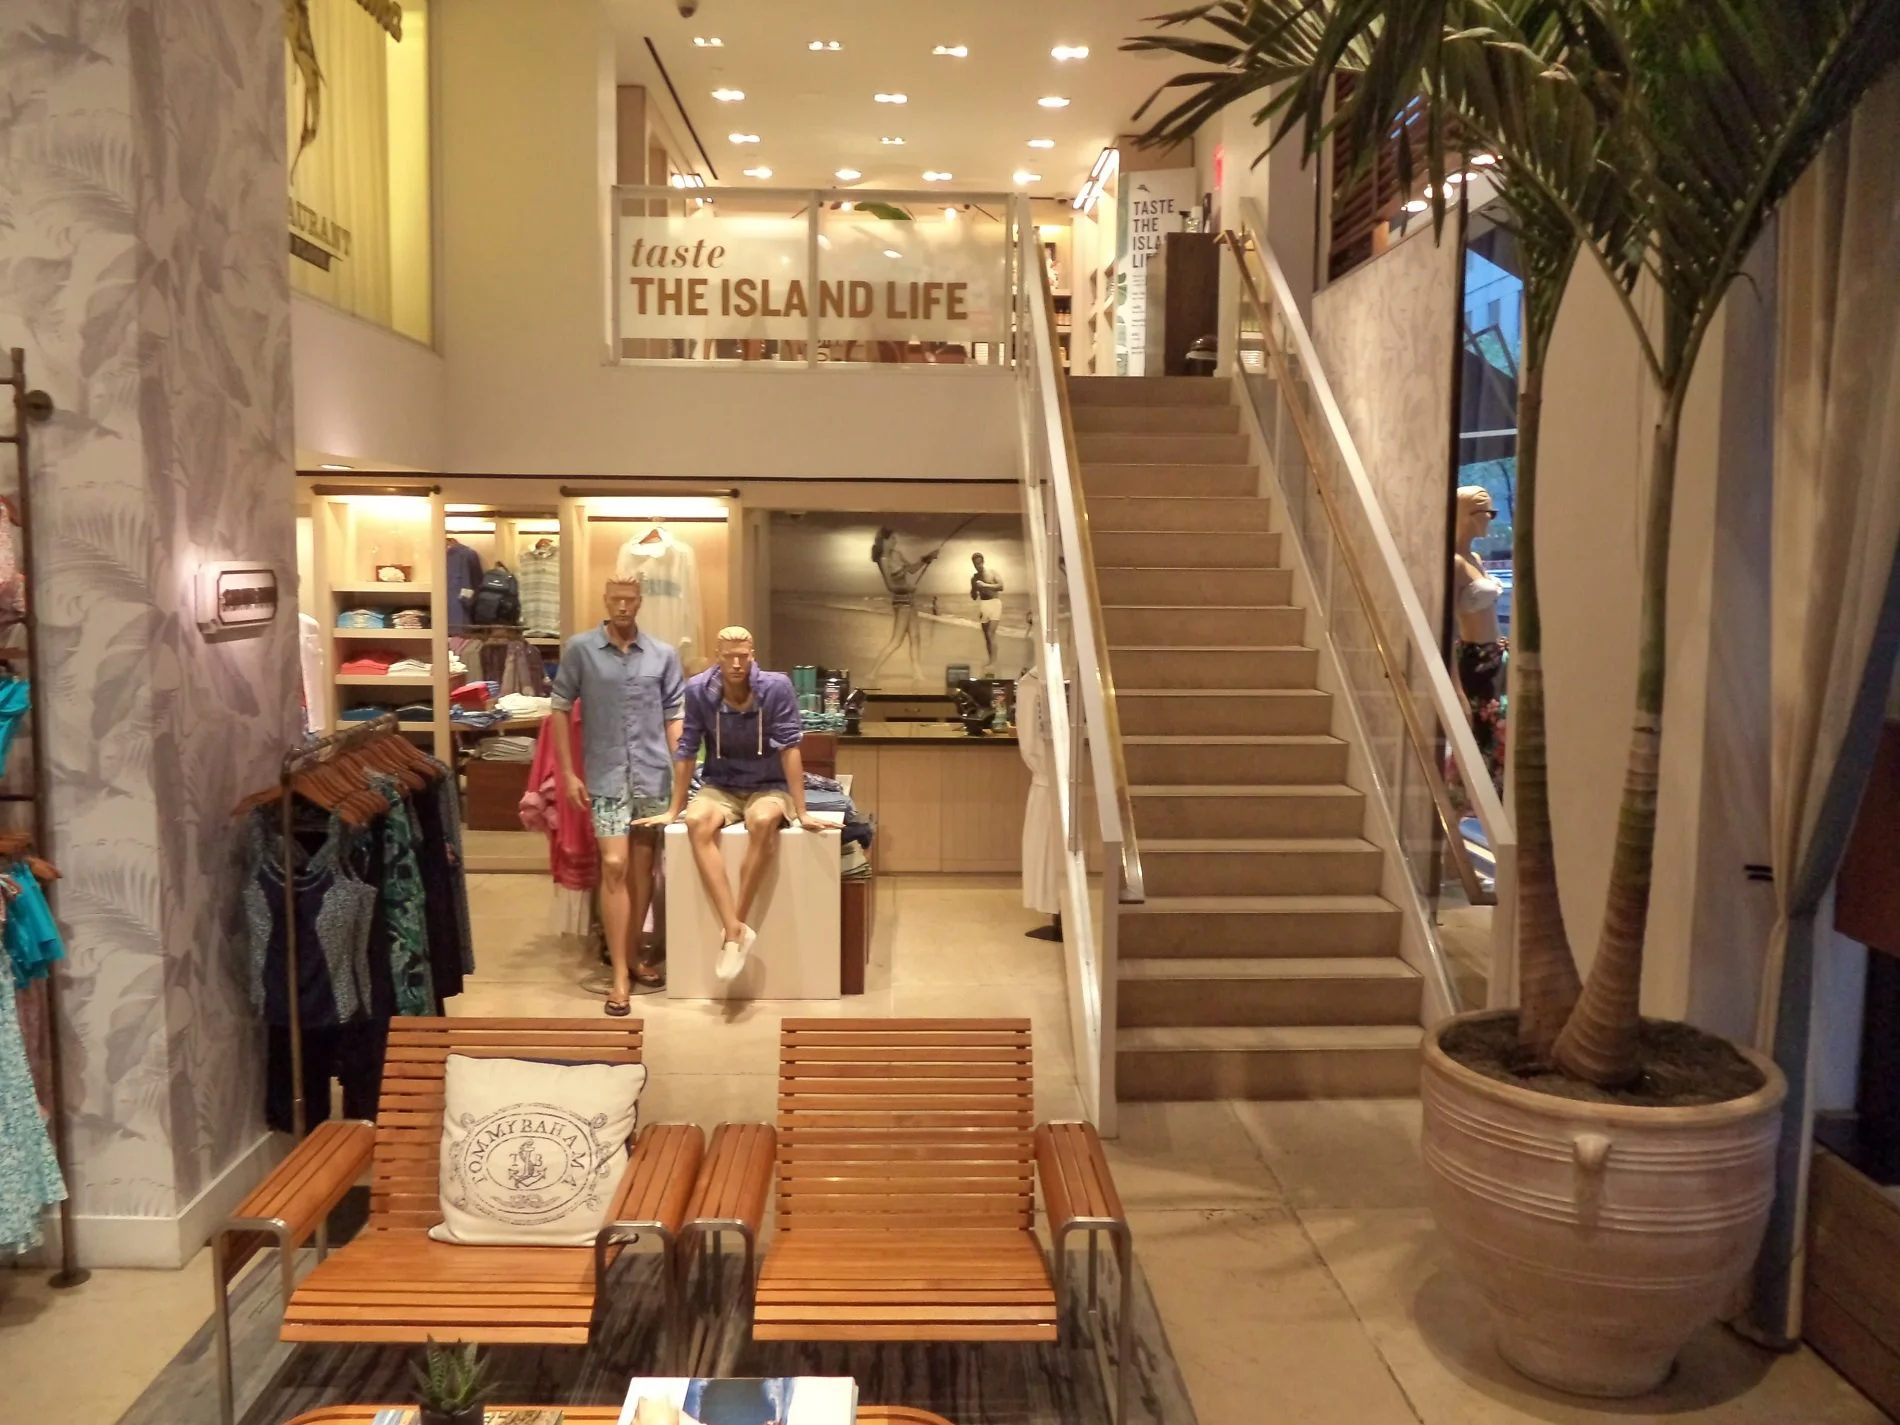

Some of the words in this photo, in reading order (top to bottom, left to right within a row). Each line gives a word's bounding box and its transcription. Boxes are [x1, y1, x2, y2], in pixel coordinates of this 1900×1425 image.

[1132, 198, 1174, 215] TASTE
[1132, 217, 1159, 233] THE
[631, 238, 725, 268] taste
[1132, 235, 1161, 250] ISLA
[630, 277, 708, 315] THE
[722, 279, 874, 318] ISLAND
[886, 281, 968, 320] LIFE
[468, 1119, 517, 1184] TOMMY
[520, 1119, 586, 1187] BAHAMA
